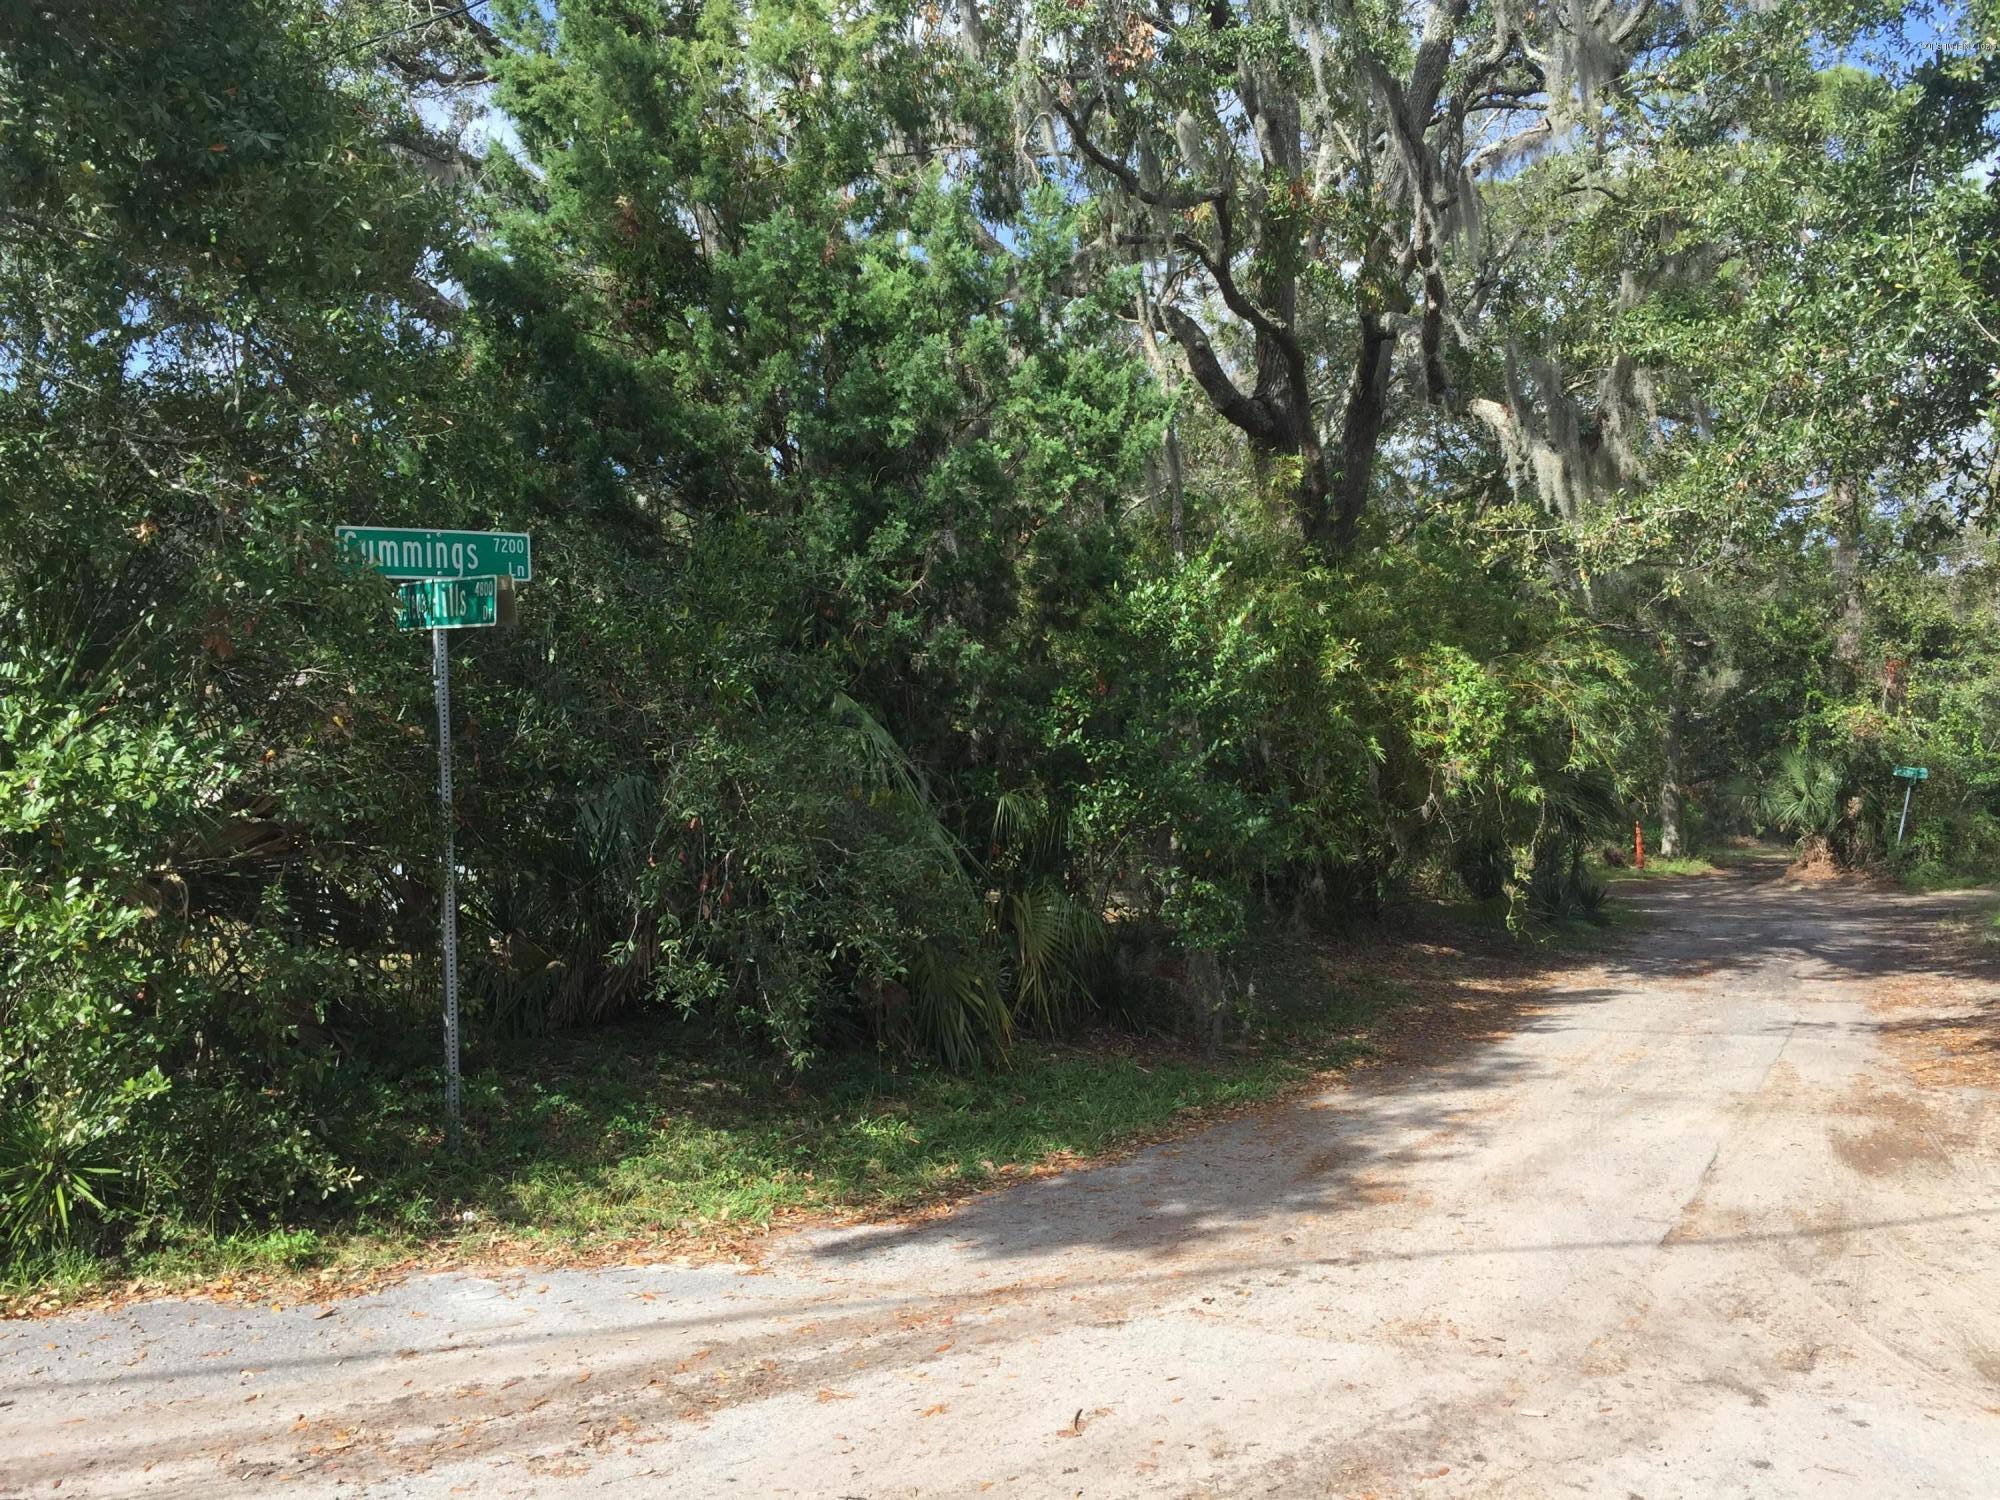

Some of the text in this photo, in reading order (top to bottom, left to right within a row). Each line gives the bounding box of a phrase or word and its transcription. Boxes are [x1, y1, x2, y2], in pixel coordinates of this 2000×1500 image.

[493, 538, 524, 553] 7200
[508, 562, 525, 577] Ln
[475, 581, 493, 597] 4800
[483, 605, 493, 621] Dr
